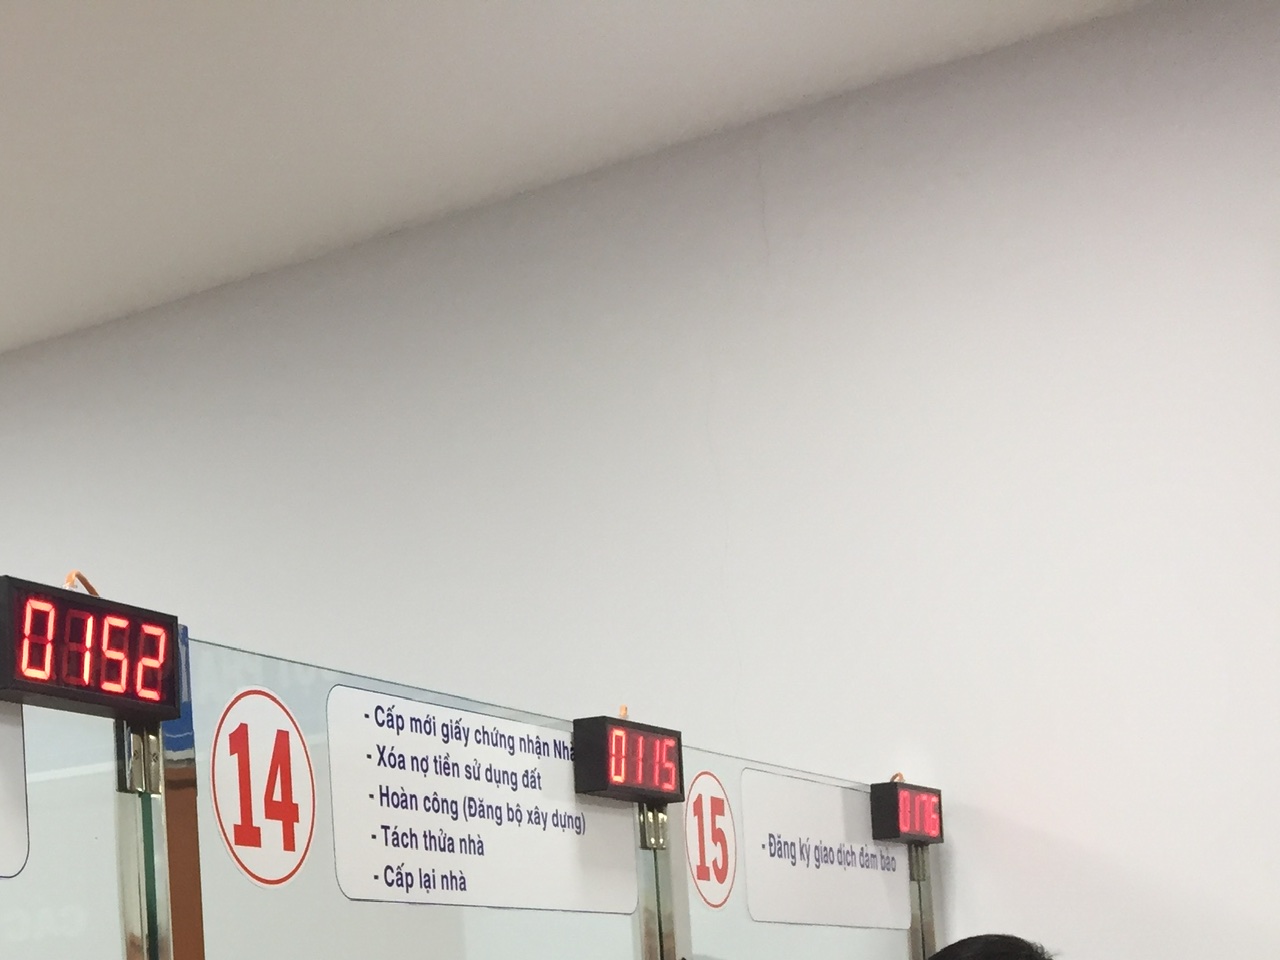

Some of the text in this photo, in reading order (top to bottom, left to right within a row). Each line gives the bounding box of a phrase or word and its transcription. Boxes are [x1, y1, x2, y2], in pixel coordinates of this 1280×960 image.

[22, 598, 167, 702] 0152
[374, 704, 405, 736] Cấp
[409, 714, 437, 737] mới
[441, 718, 470, 747] giấy
[474, 725, 516, 756] chứng
[519, 734, 550, 761] nhận
[376, 743, 542, 792] Xóa nợ tiền sử dụng đất
[609, 728, 676, 792] 0115
[229, 723, 299, 852] 14
[378, 785, 587, 836] Hoàn công (Đăng bộ xây dựng)
[380, 825, 485, 856] Tách thửa nhà
[693, 792, 729, 885] 15
[768, 833, 797, 867] Đăng
[799, 837, 812, 868] ký
[814, 840, 835, 869] giao
[836, 843, 858, 871] dịch
[384, 862, 468, 895] Cấp lại nhà
